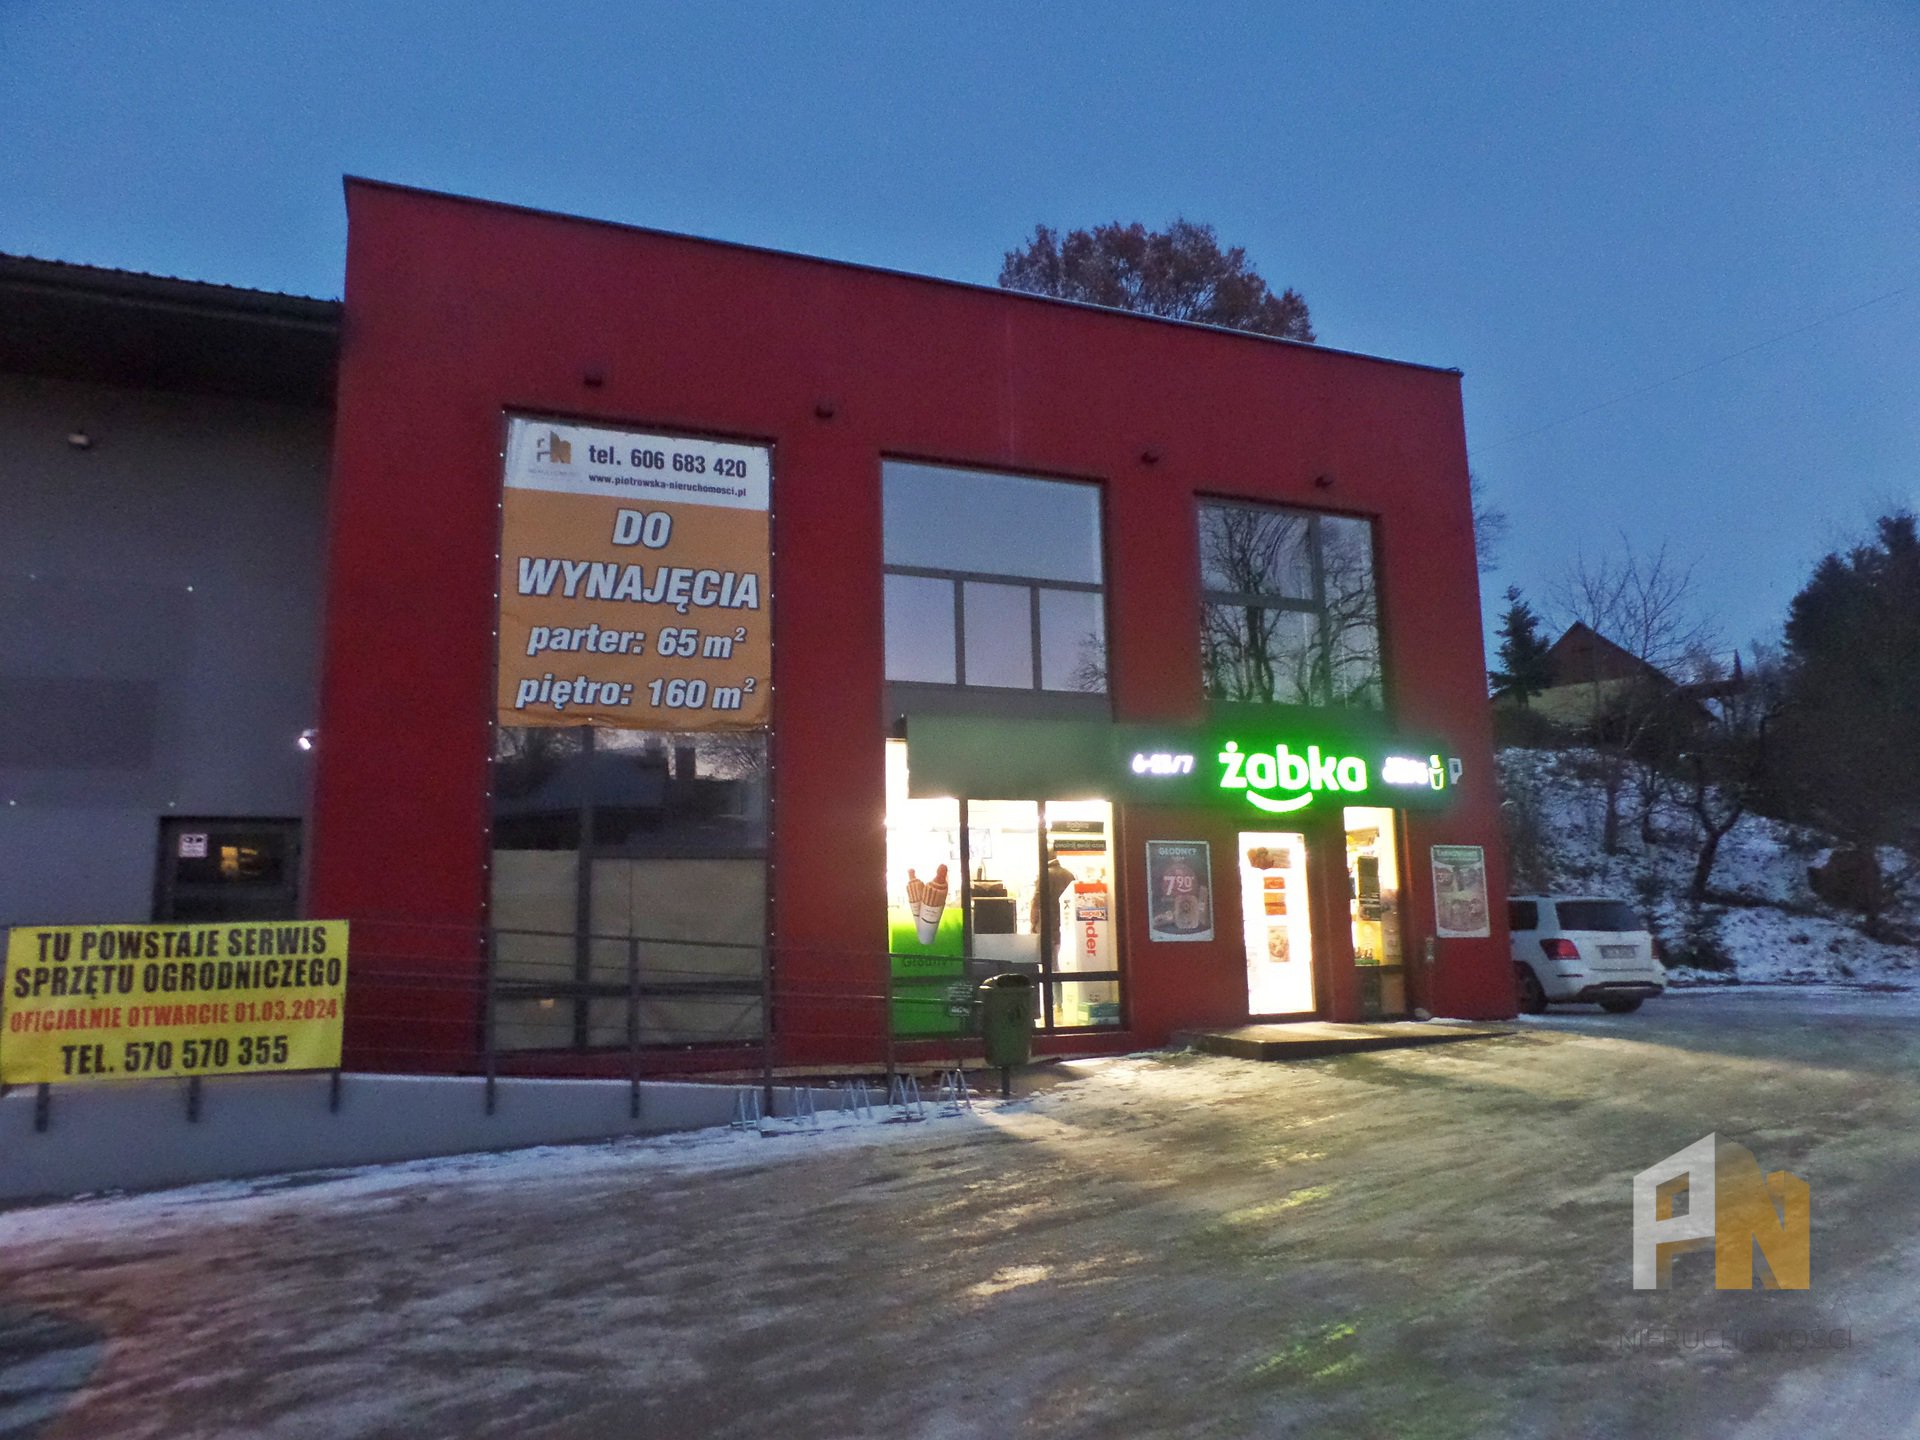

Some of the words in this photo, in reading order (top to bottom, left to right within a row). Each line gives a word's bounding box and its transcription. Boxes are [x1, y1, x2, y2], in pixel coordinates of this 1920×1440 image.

[588, 445, 622, 466] tel.
[630, 449, 665, 470] 606
[672, 452, 706, 475] 683
[713, 457, 747, 479] 420
[588, 473, 747, 498] www.piotrowska-nieruchomosci.pl
[612, 507, 673, 549] DO
[517, 556, 760, 614] WYNAJĘCIA
[526, 623, 645, 656] parter:
[656, 626, 699, 658] 65
[514, 673, 634, 711] piętro:
[647, 678, 707, 709] 160
[1218, 741, 1368, 792] żabka
[38, 932, 71, 962] TU
[81, 931, 220, 961] POWSTAJE
[227, 926, 327, 956] SERWIS
[14, 964, 134, 999] SPRZĘTU
[143, 957, 342, 993] OGRODNICZEGO
[10, 1007, 122, 1032] OFICJALNIE
[128, 1002, 229, 1027] OTWARCIE
[234, 998, 337, 1023] 01.03.2024
[62, 1044, 114, 1074] TEL.
[124, 1041, 173, 1072] 570
[182, 1038, 229, 1068] 570
[237, 1035, 288, 1066] 355
